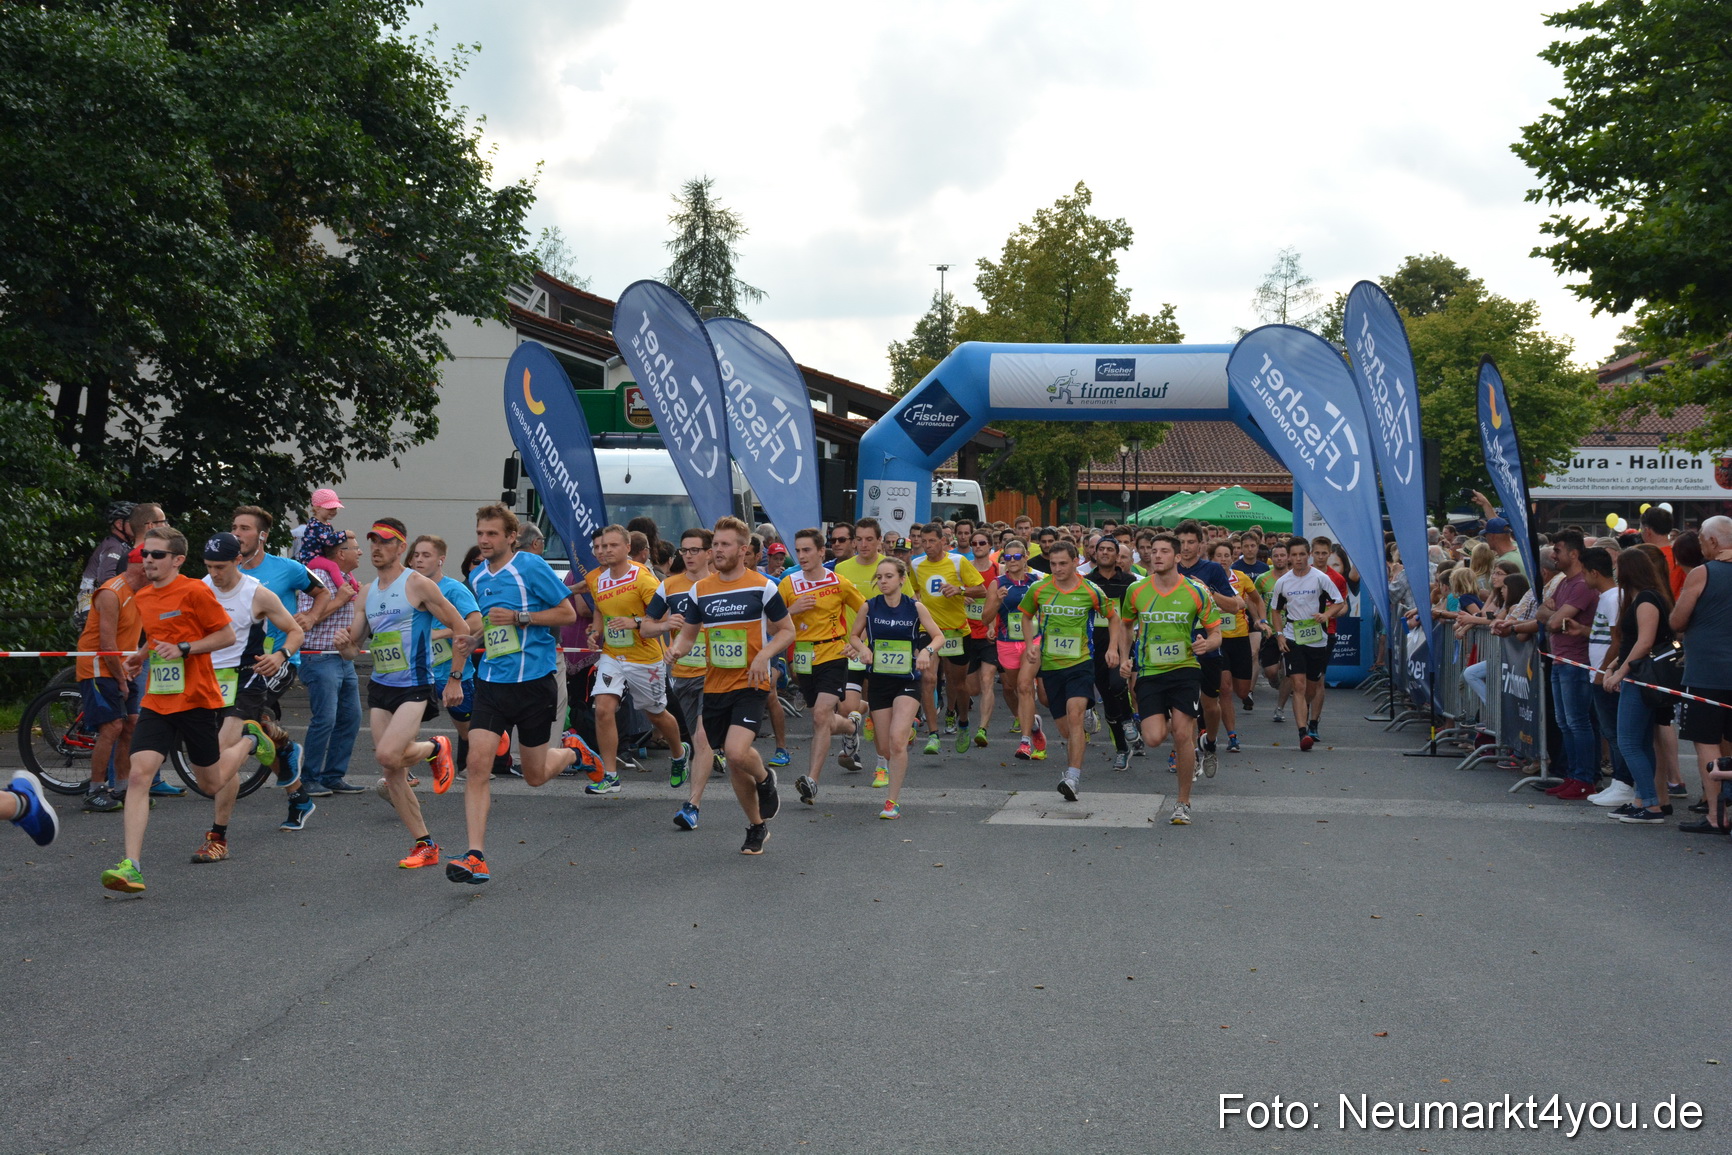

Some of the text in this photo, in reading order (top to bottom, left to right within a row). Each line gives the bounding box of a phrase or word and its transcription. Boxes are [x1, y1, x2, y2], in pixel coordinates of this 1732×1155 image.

[1081, 382, 1169, 398] firmenlauf
[912, 411, 960, 422] Fischer
[1559, 456, 1608, 469] Jura
[1630, 455, 1702, 469] Hallen
[597, 584, 638, 602] MAX BÖGL
[820, 587, 842, 598] BÖGL
[711, 604, 748, 614] Fischer
[1042, 604, 1086, 616] BOCK
[1140, 612, 1190, 624] BOCK
[488, 628, 508, 646] 522
[607, 628, 626, 638] 891
[1300, 628, 1317, 638] 285
[1053, 638, 1075, 649] 147
[373, 647, 401, 662] 1336
[712, 644, 742, 657] 1638
[1156, 645, 1180, 656] 145
[881, 654, 904, 664] 372
[152, 666, 180, 682] 1028
